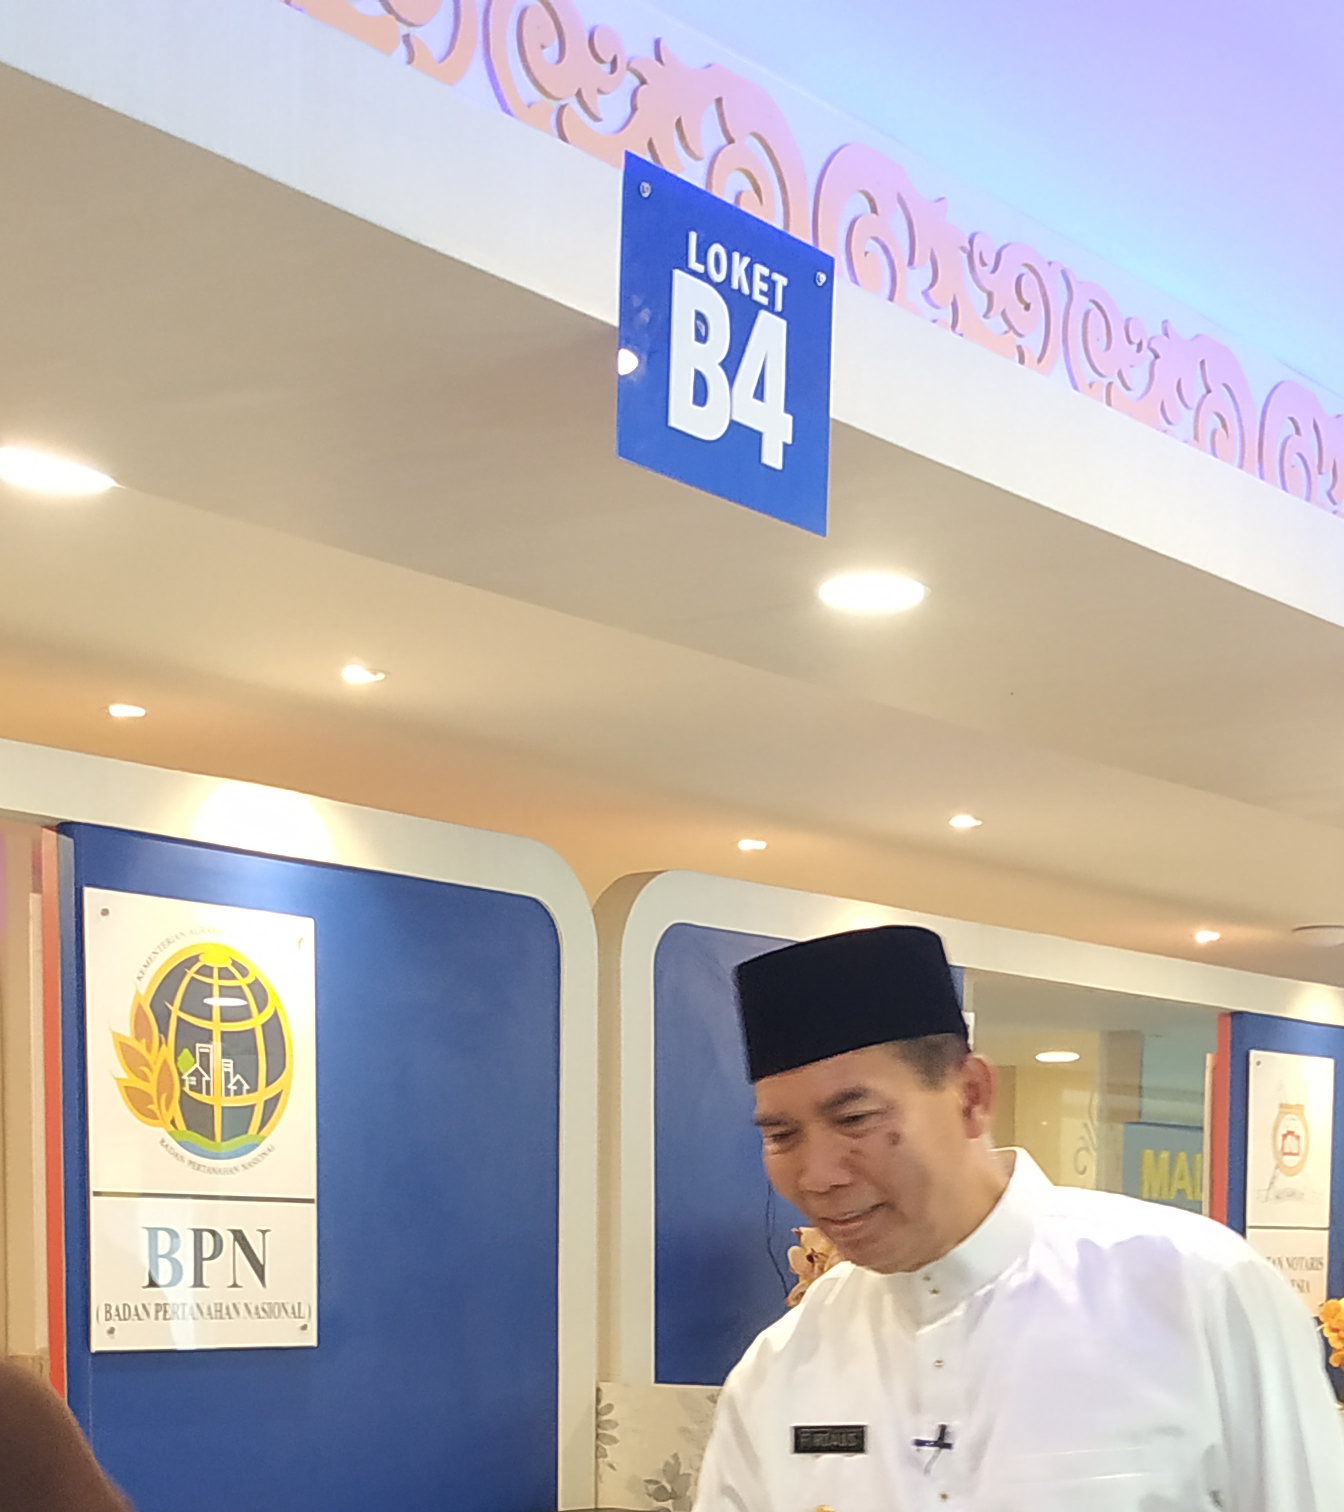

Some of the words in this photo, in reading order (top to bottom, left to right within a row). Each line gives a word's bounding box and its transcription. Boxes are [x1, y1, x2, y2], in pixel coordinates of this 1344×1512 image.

[688, 230, 788, 313] LOKET
[667, 267, 794, 471] B4
[141, 1226, 272, 1290] BPN
[155, 1302, 242, 1323] PERTANAHAN
